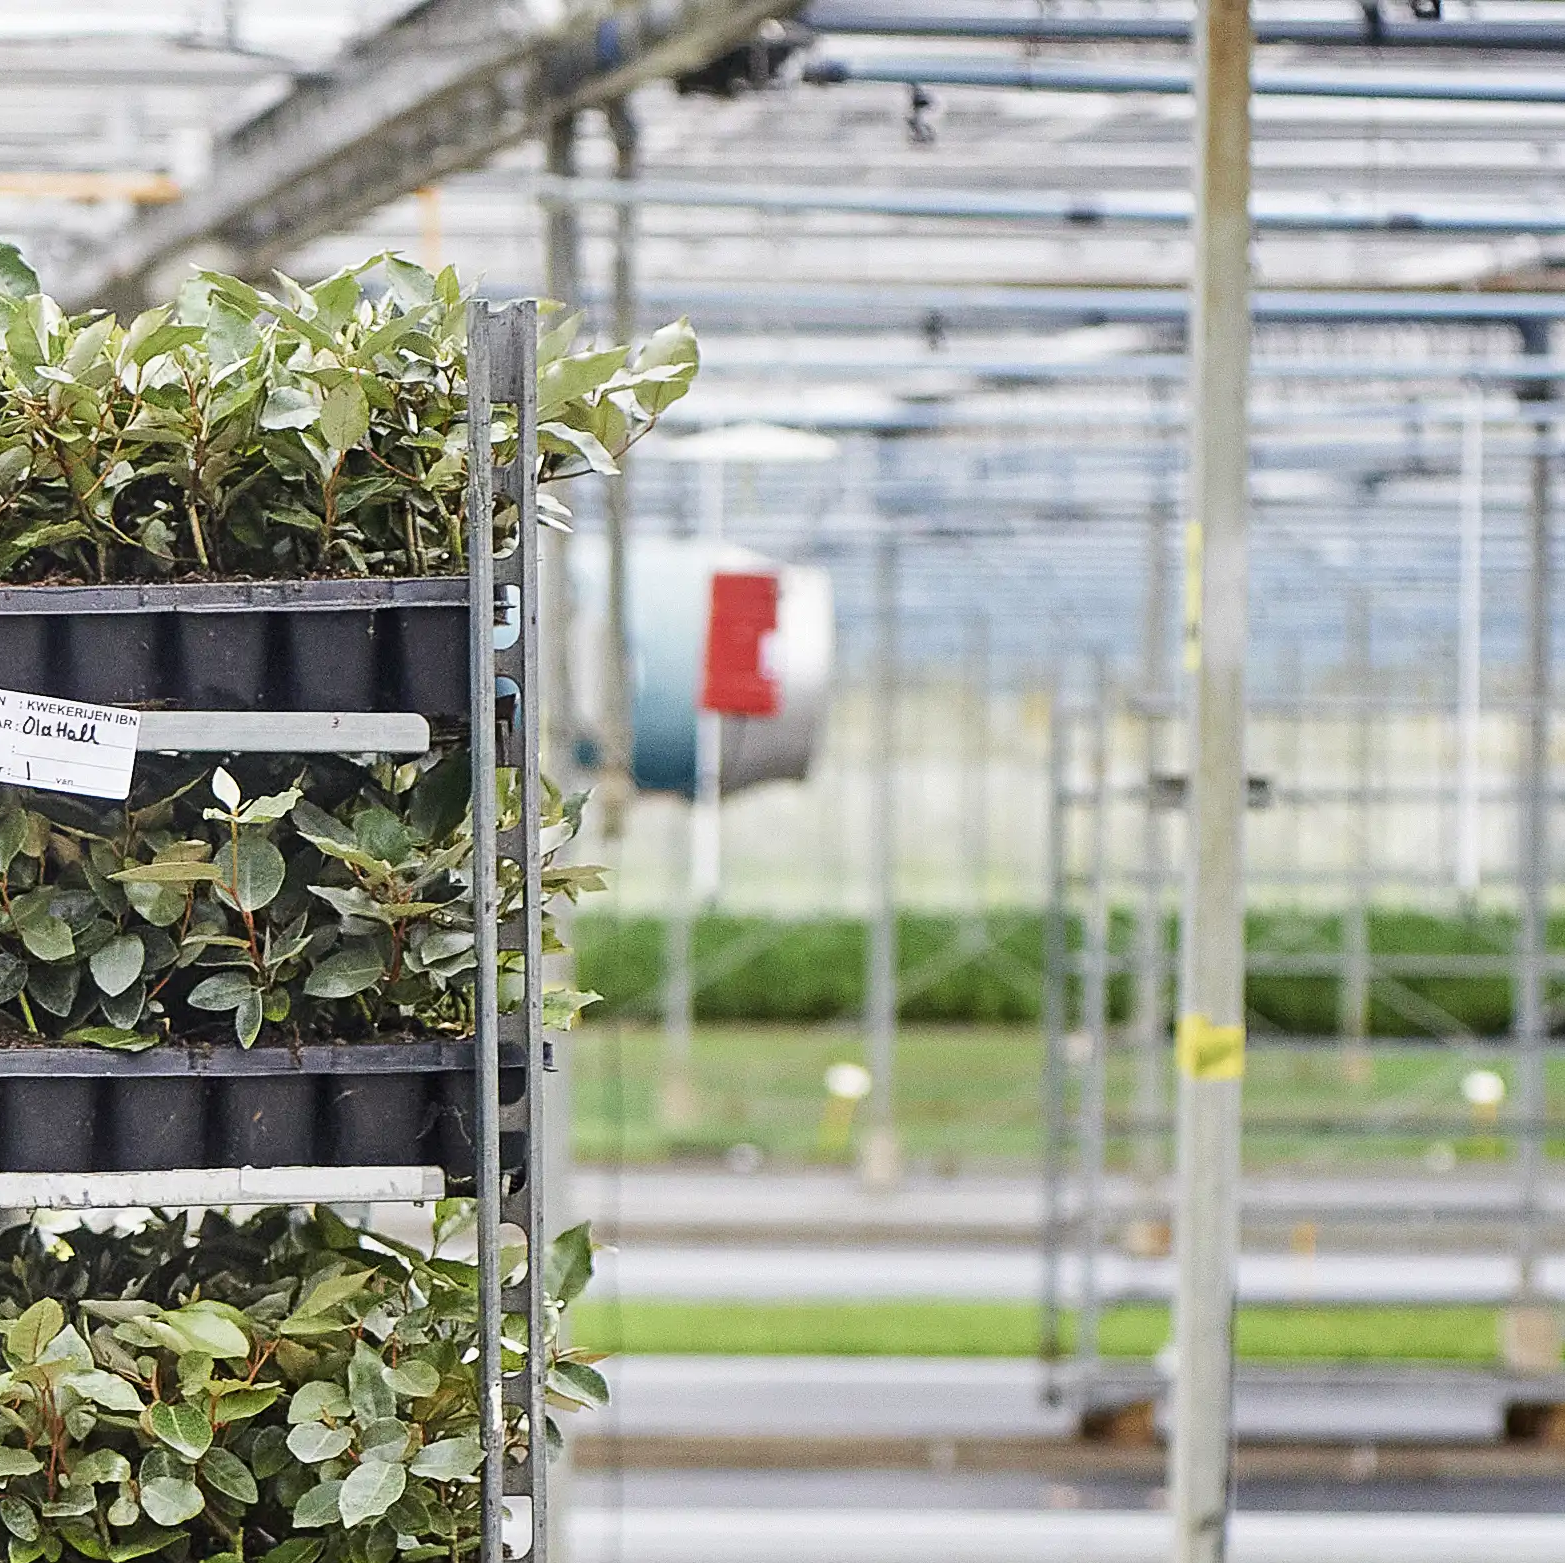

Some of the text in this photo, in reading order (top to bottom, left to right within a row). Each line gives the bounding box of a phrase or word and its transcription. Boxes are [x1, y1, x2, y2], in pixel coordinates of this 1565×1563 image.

[27, 700, 112, 722] KWEKERIJEN
[115, 713, 138, 726] IBN
[55, 777, 74, 787] van
